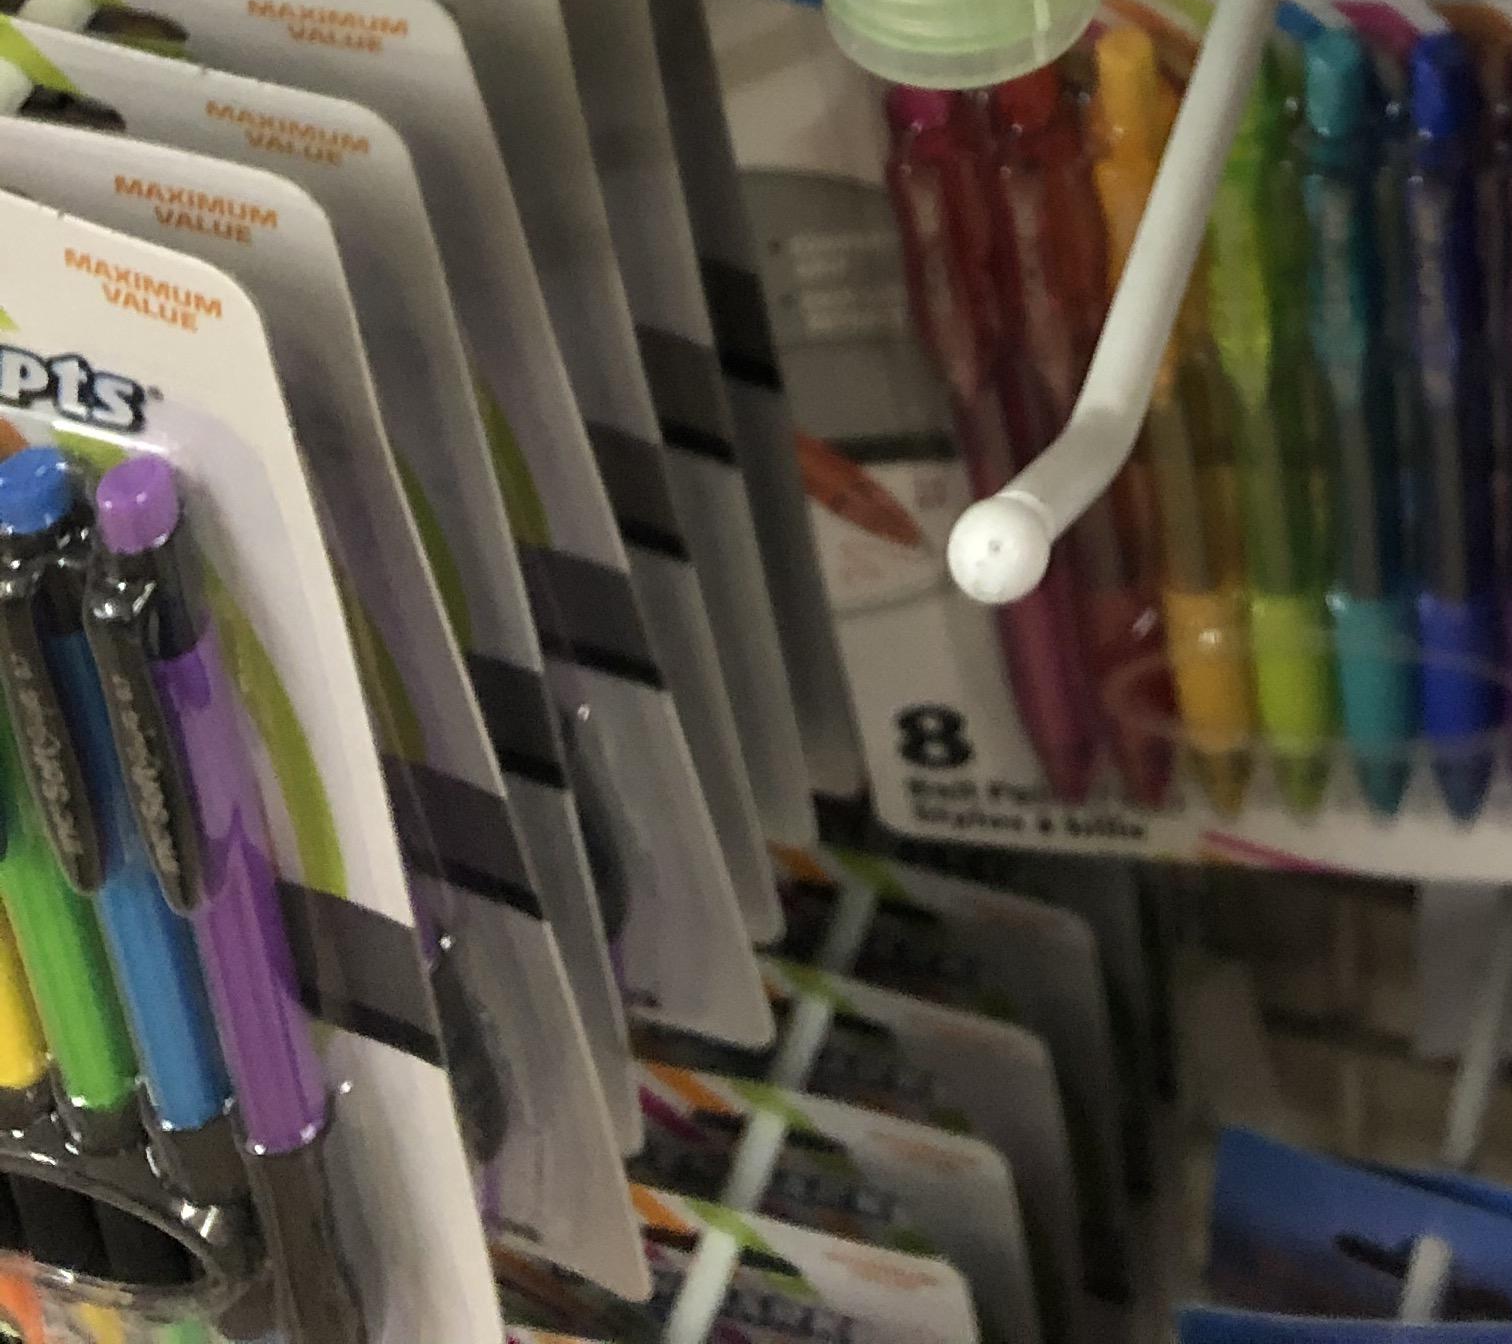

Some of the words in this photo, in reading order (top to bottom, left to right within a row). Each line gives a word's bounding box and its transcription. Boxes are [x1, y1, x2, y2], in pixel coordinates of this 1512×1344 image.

[287, 23, 383, 54] VALUE
[205, 99, 371, 155] MAXIMUM
[246, 130, 343, 166] VALUE
[113, 174, 279, 229] MAXIMUM
[154, 205, 252, 245] VALUE
[64, 247, 223, 319] MAXIMUM
[101, 282, 198, 333] VALUE
[895, 703, 975, 769] 8
